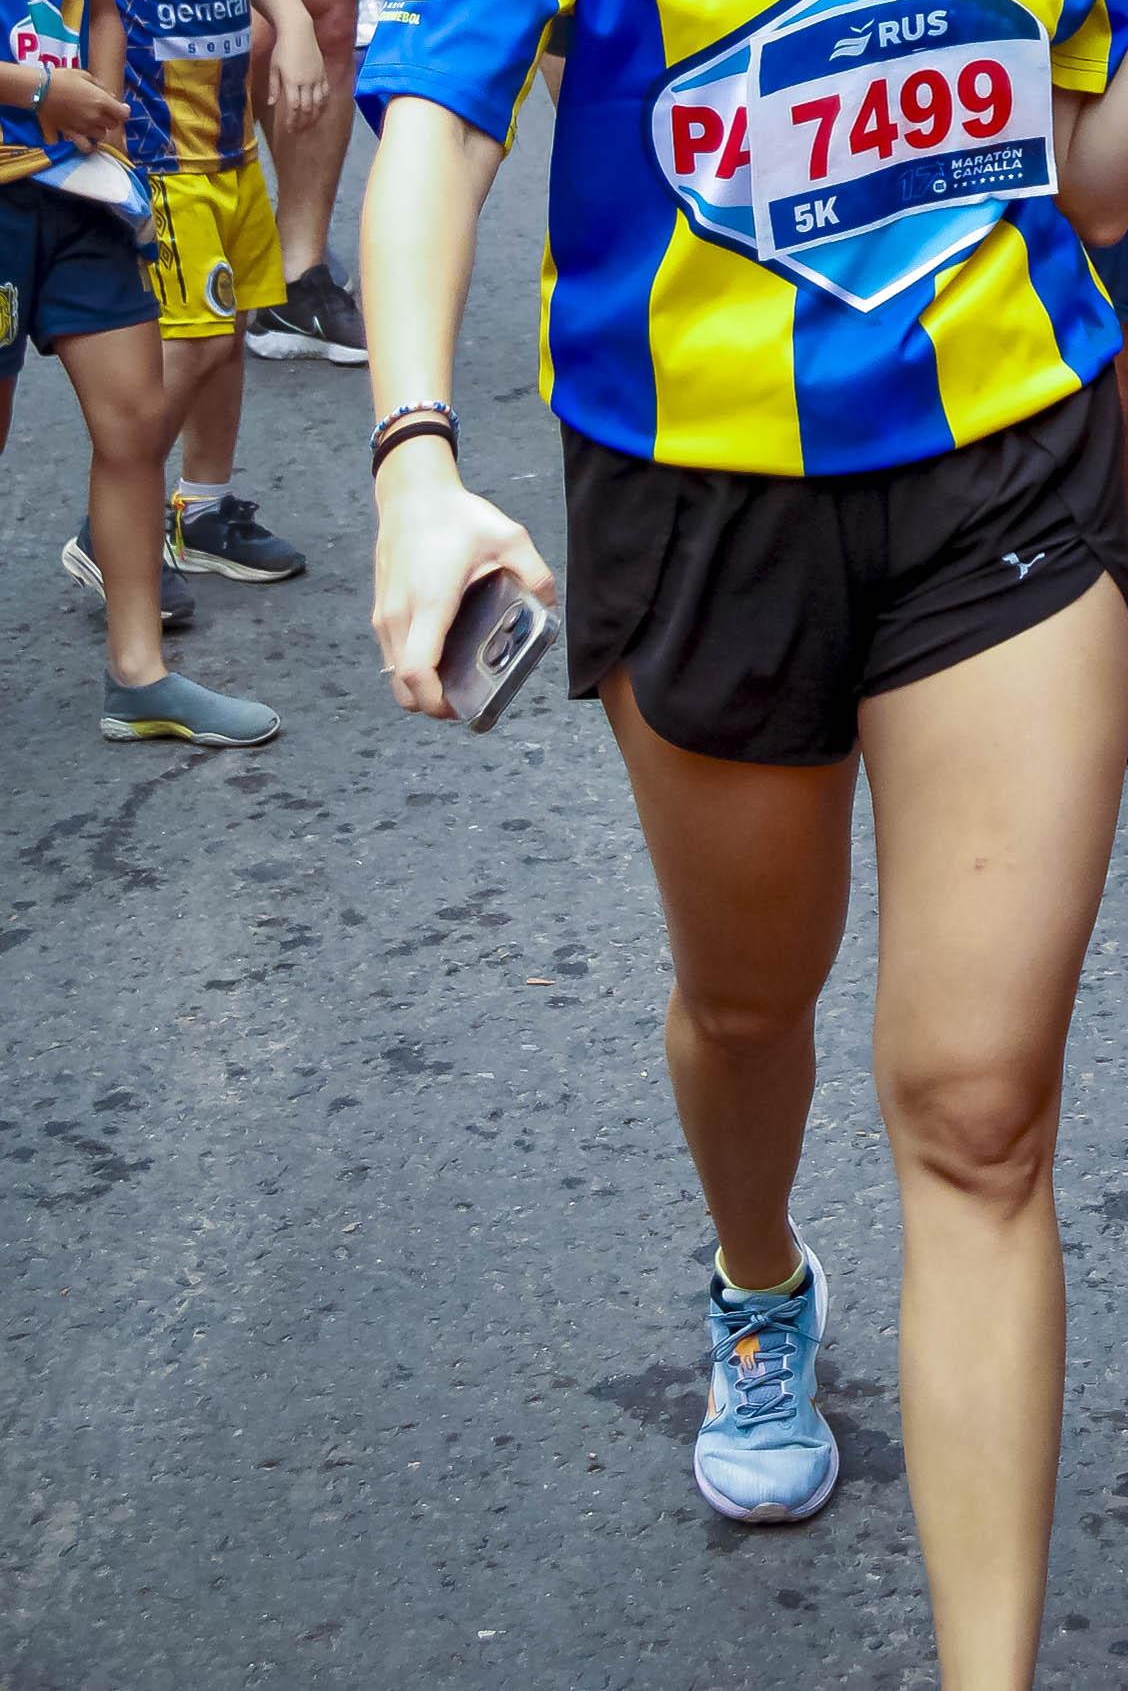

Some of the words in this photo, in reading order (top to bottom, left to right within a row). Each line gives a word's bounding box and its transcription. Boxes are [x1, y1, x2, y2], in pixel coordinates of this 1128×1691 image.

[878, 10, 949, 49] RUS
[187, 36, 250, 55] segu
[791, 59, 1014, 183] 7499
[951, 146, 1024, 170] MARATÓN
[952, 159, 1024, 180] CANALLA
[793, 195, 840, 235] 5K
